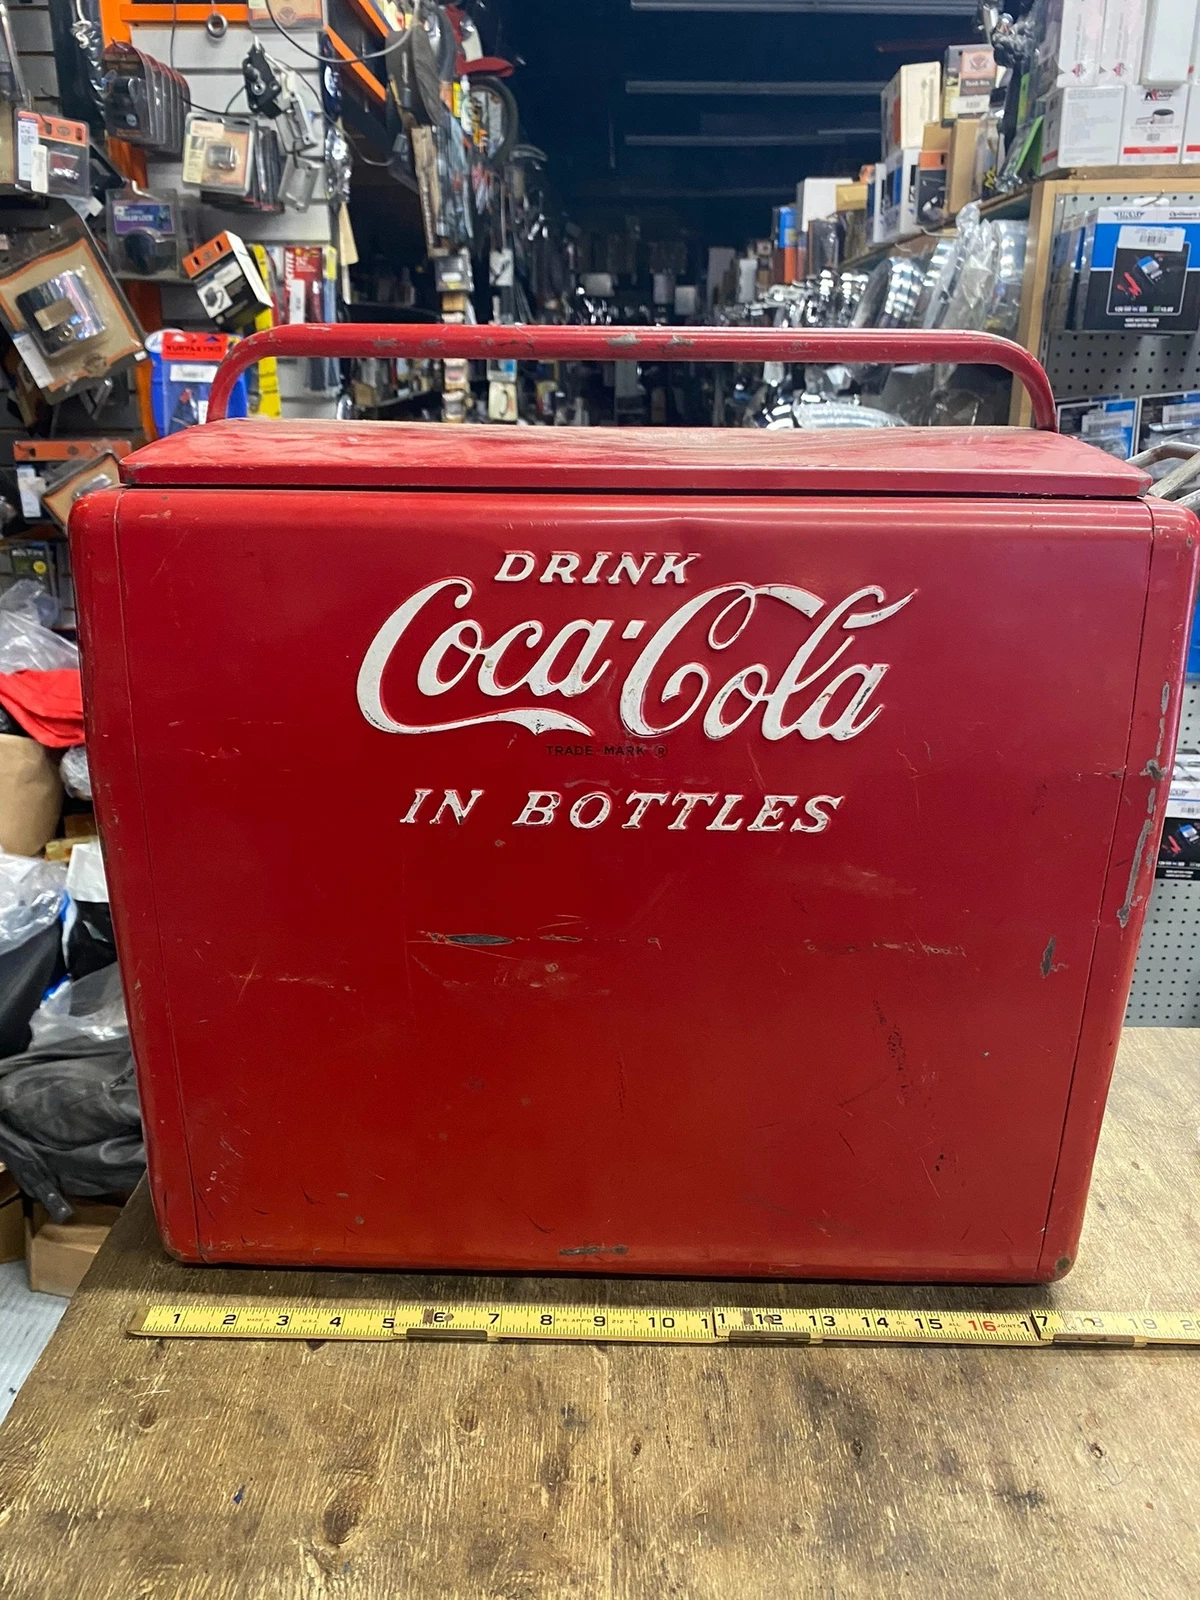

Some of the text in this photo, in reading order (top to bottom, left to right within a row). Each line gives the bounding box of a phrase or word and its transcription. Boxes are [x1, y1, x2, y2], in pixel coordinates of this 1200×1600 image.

[495, 550, 701, 585] DRINK
[357, 577, 917, 741] Coca-Cola
[546, 745, 593, 756] TRADE
[604, 745, 645, 756] MARK
[401, 789, 844, 834] IN BOTTLES
[173, 1313, 181, 1324] 1
[222, 1314, 237, 1325] 2
[276, 1315, 289, 1326] 3
[329, 1316, 342, 1327] 4
[382, 1317, 395, 1329] 5
[488, 1313, 500, 1324] 7
[540, 1314, 553, 1326] 8
[593, 1315, 606, 1327] 9
[648, 1316, 675, 1328] 10
[755, 1313, 783, 1325] 12
[808, 1315, 836, 1327] 13
[861, 1316, 889, 1328] 14
[914, 1318, 943, 1330] 15
[968, 1319, 997, 1332] 16
[1128, 1318, 1157, 1330] 19
